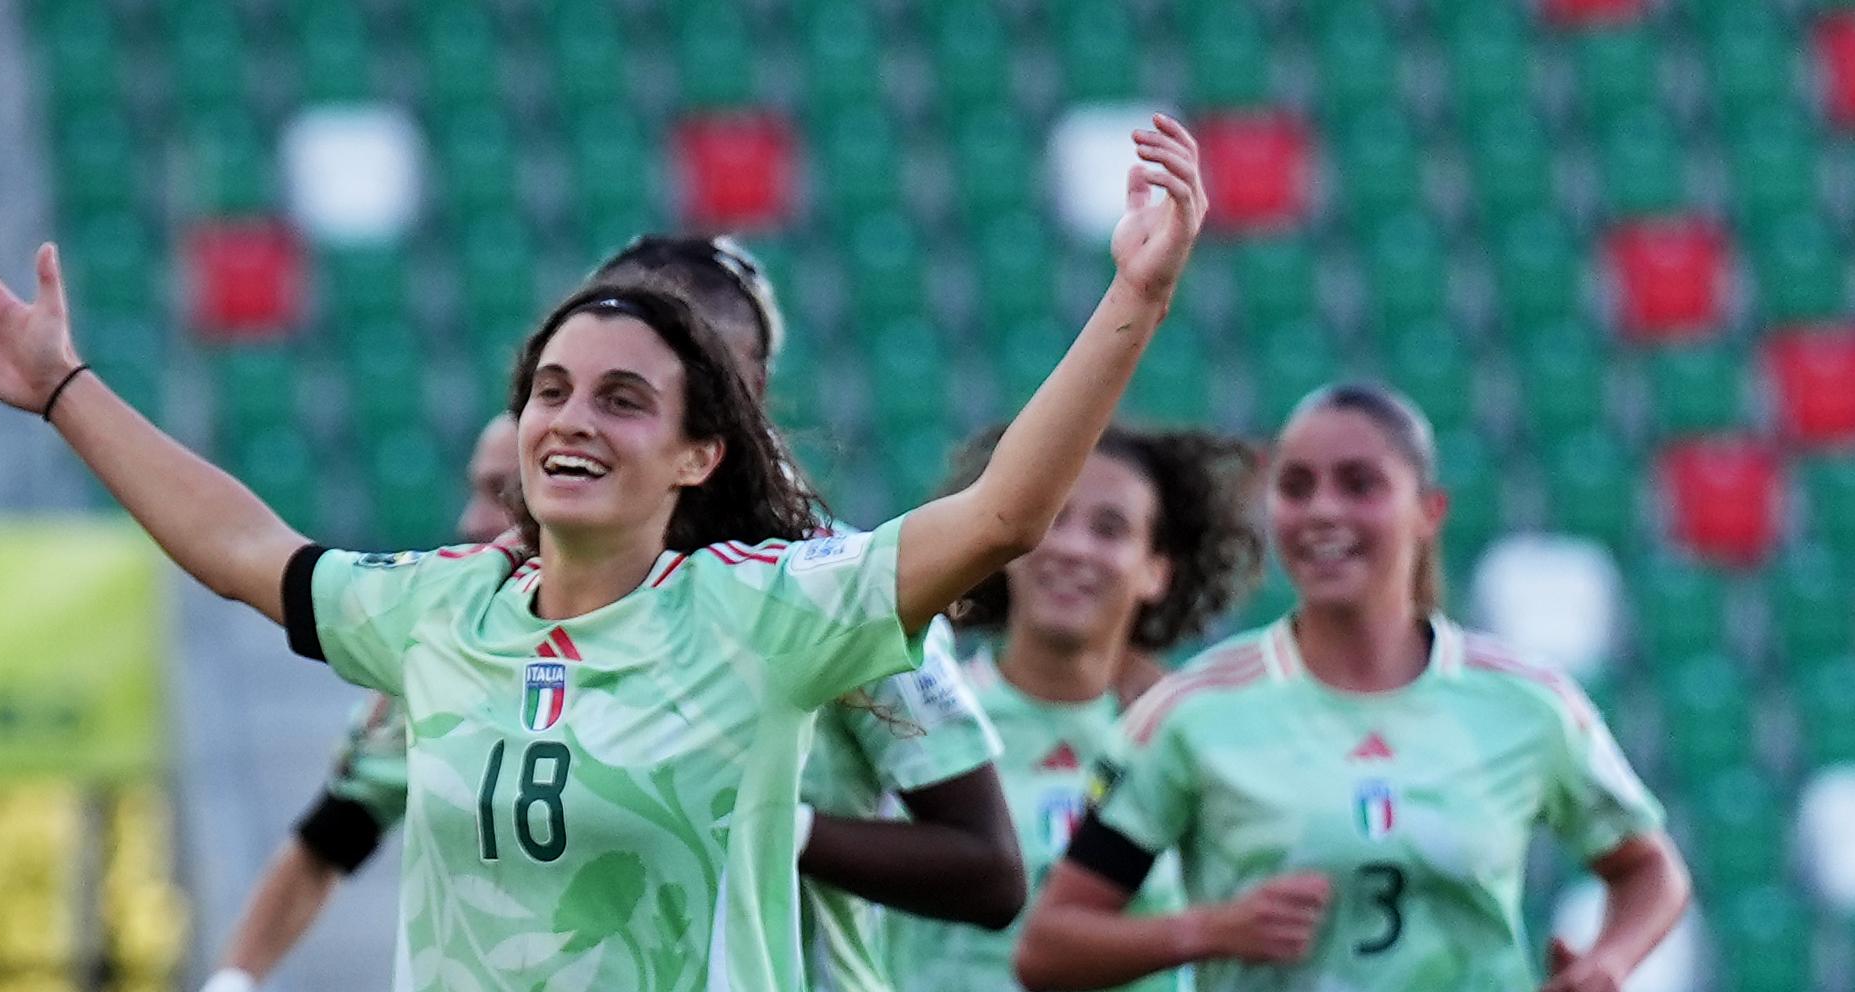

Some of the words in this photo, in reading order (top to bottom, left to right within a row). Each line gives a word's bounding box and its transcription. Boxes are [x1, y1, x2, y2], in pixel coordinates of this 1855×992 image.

[527, 665, 564, 682] ITALIA
[478, 738, 571, 863] 18
[1353, 863, 1407, 955] 3
